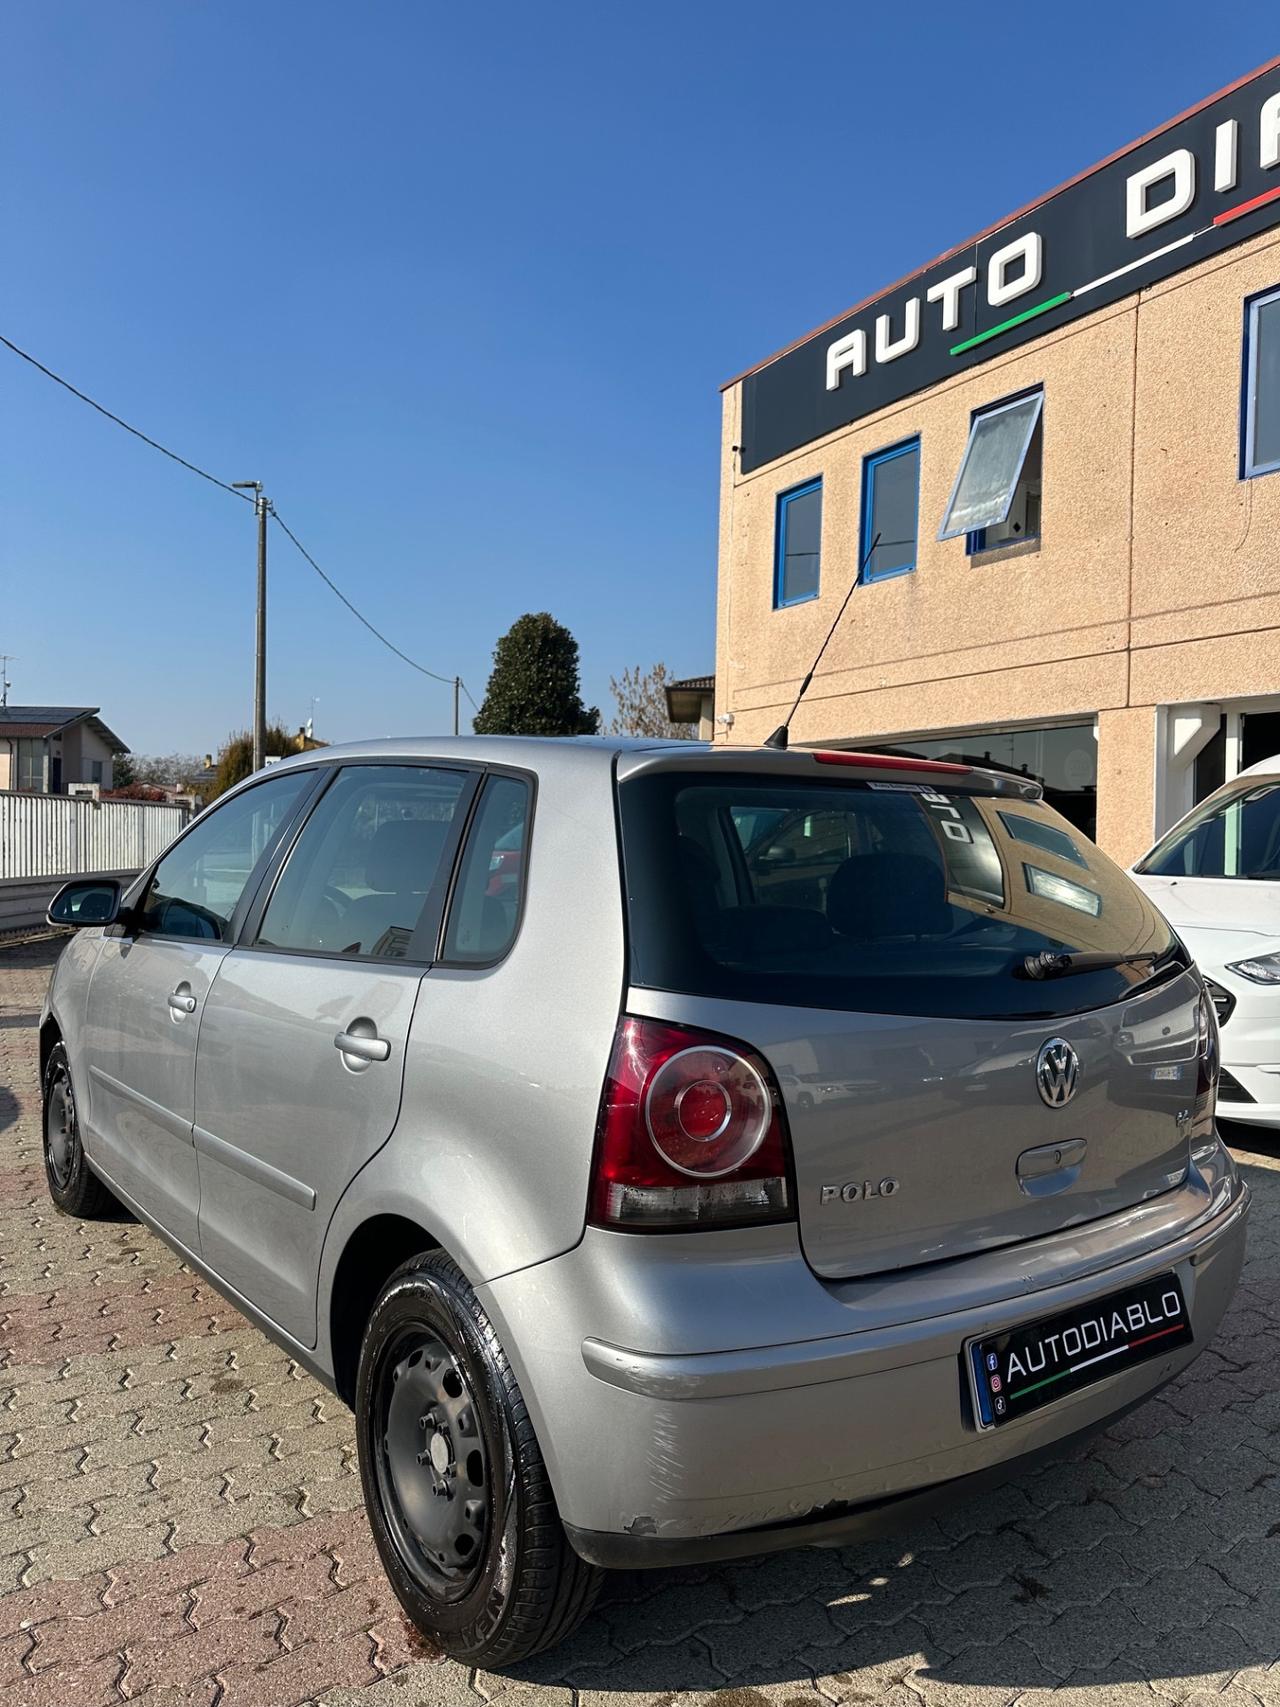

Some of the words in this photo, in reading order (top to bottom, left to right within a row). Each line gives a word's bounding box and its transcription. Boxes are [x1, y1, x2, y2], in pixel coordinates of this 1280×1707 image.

[826, 232, 1041, 391] AUTO
[820, 1177, 900, 1205] POLO
[1006, 1290, 1182, 1383] AUTODIABLO
